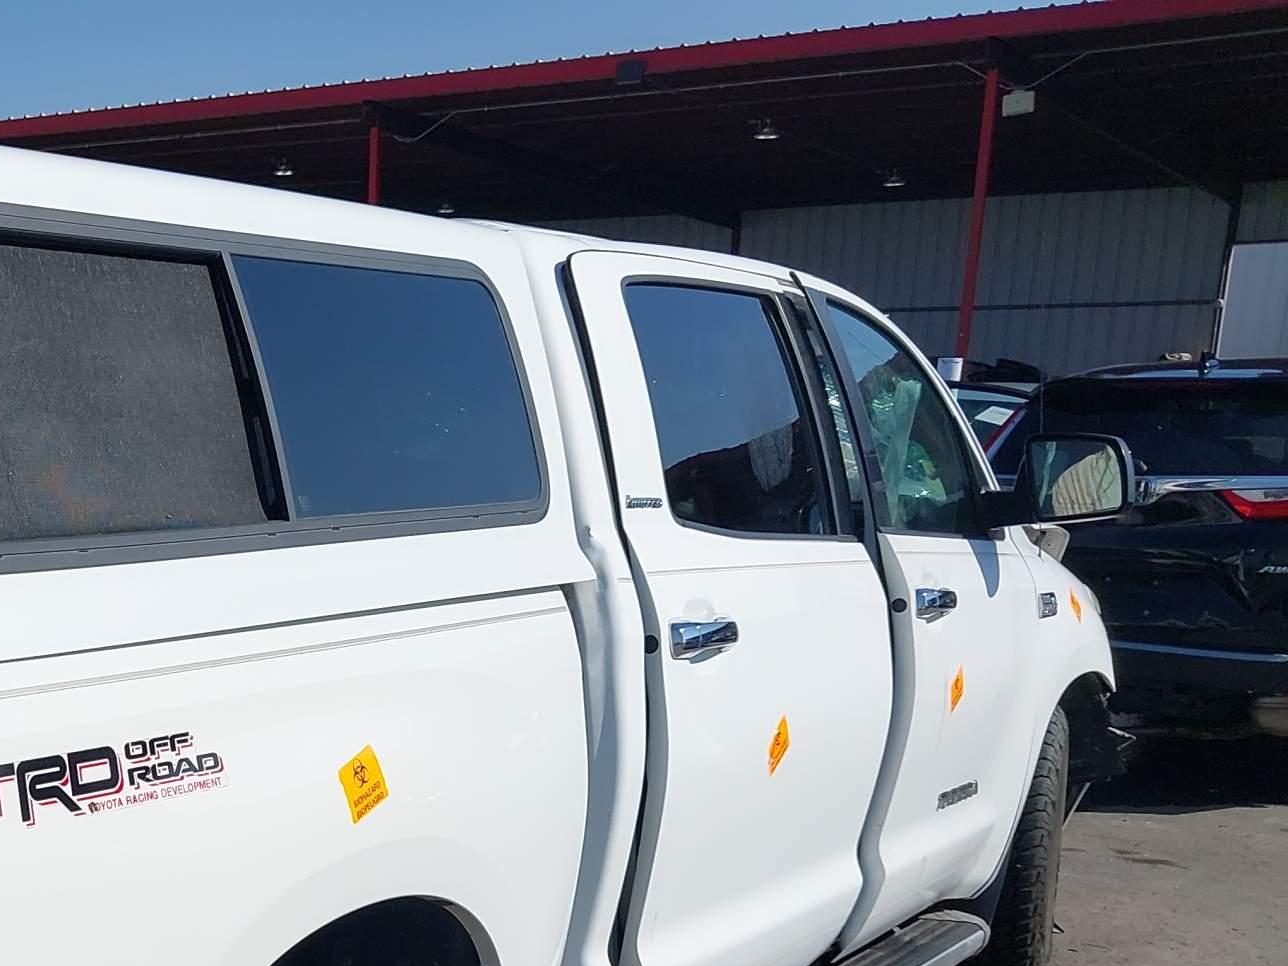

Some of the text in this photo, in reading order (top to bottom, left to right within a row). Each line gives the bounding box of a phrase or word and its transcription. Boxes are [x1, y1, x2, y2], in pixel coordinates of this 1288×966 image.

[123, 731, 194, 764] OFF
[127, 752, 224, 790] ROAD
[88, 776, 222, 815] OYOTA RACING DEVELOPMENT
